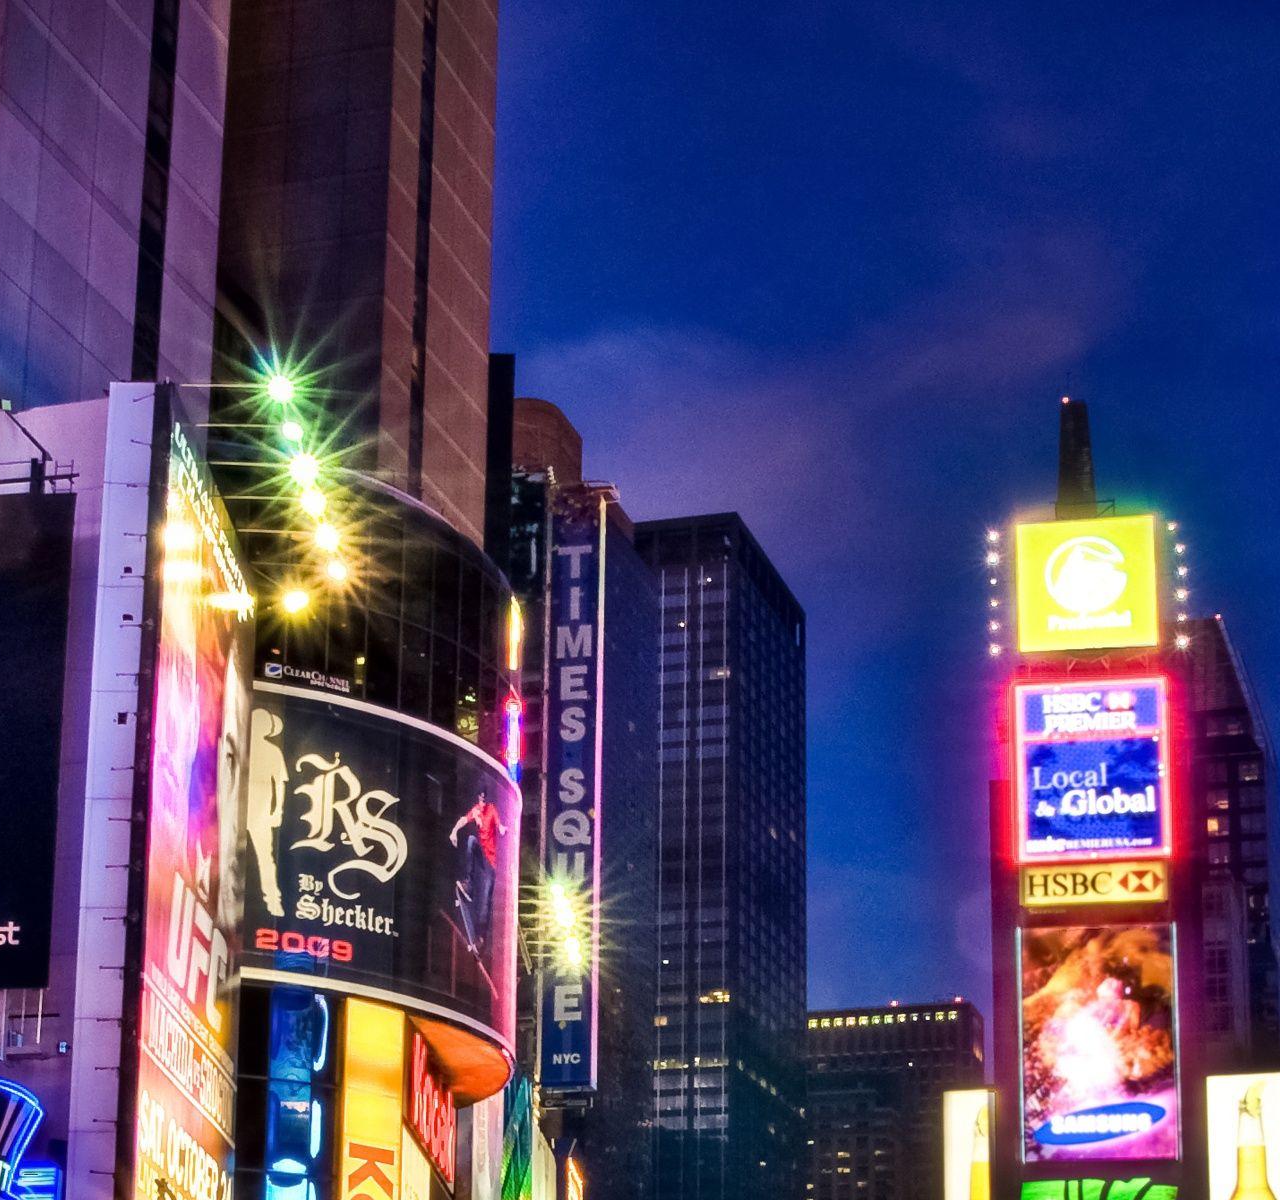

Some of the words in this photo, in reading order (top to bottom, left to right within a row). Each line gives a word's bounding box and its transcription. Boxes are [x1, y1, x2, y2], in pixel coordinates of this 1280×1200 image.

[556, 545, 593, 742] TIMES
[1042, 692, 1102, 714] HSBC
[1032, 762, 1108, 790] Local
[1060, 785, 1157, 816] Global
[298, 874, 324, 894] By
[553, 768, 593, 1022] SQUE
[1028, 871, 1113, 898] HSBC
[168, 871, 229, 1034] UFC
[255, 930, 354, 962] 2009
[552, 1054, 581, 1065] NYC
